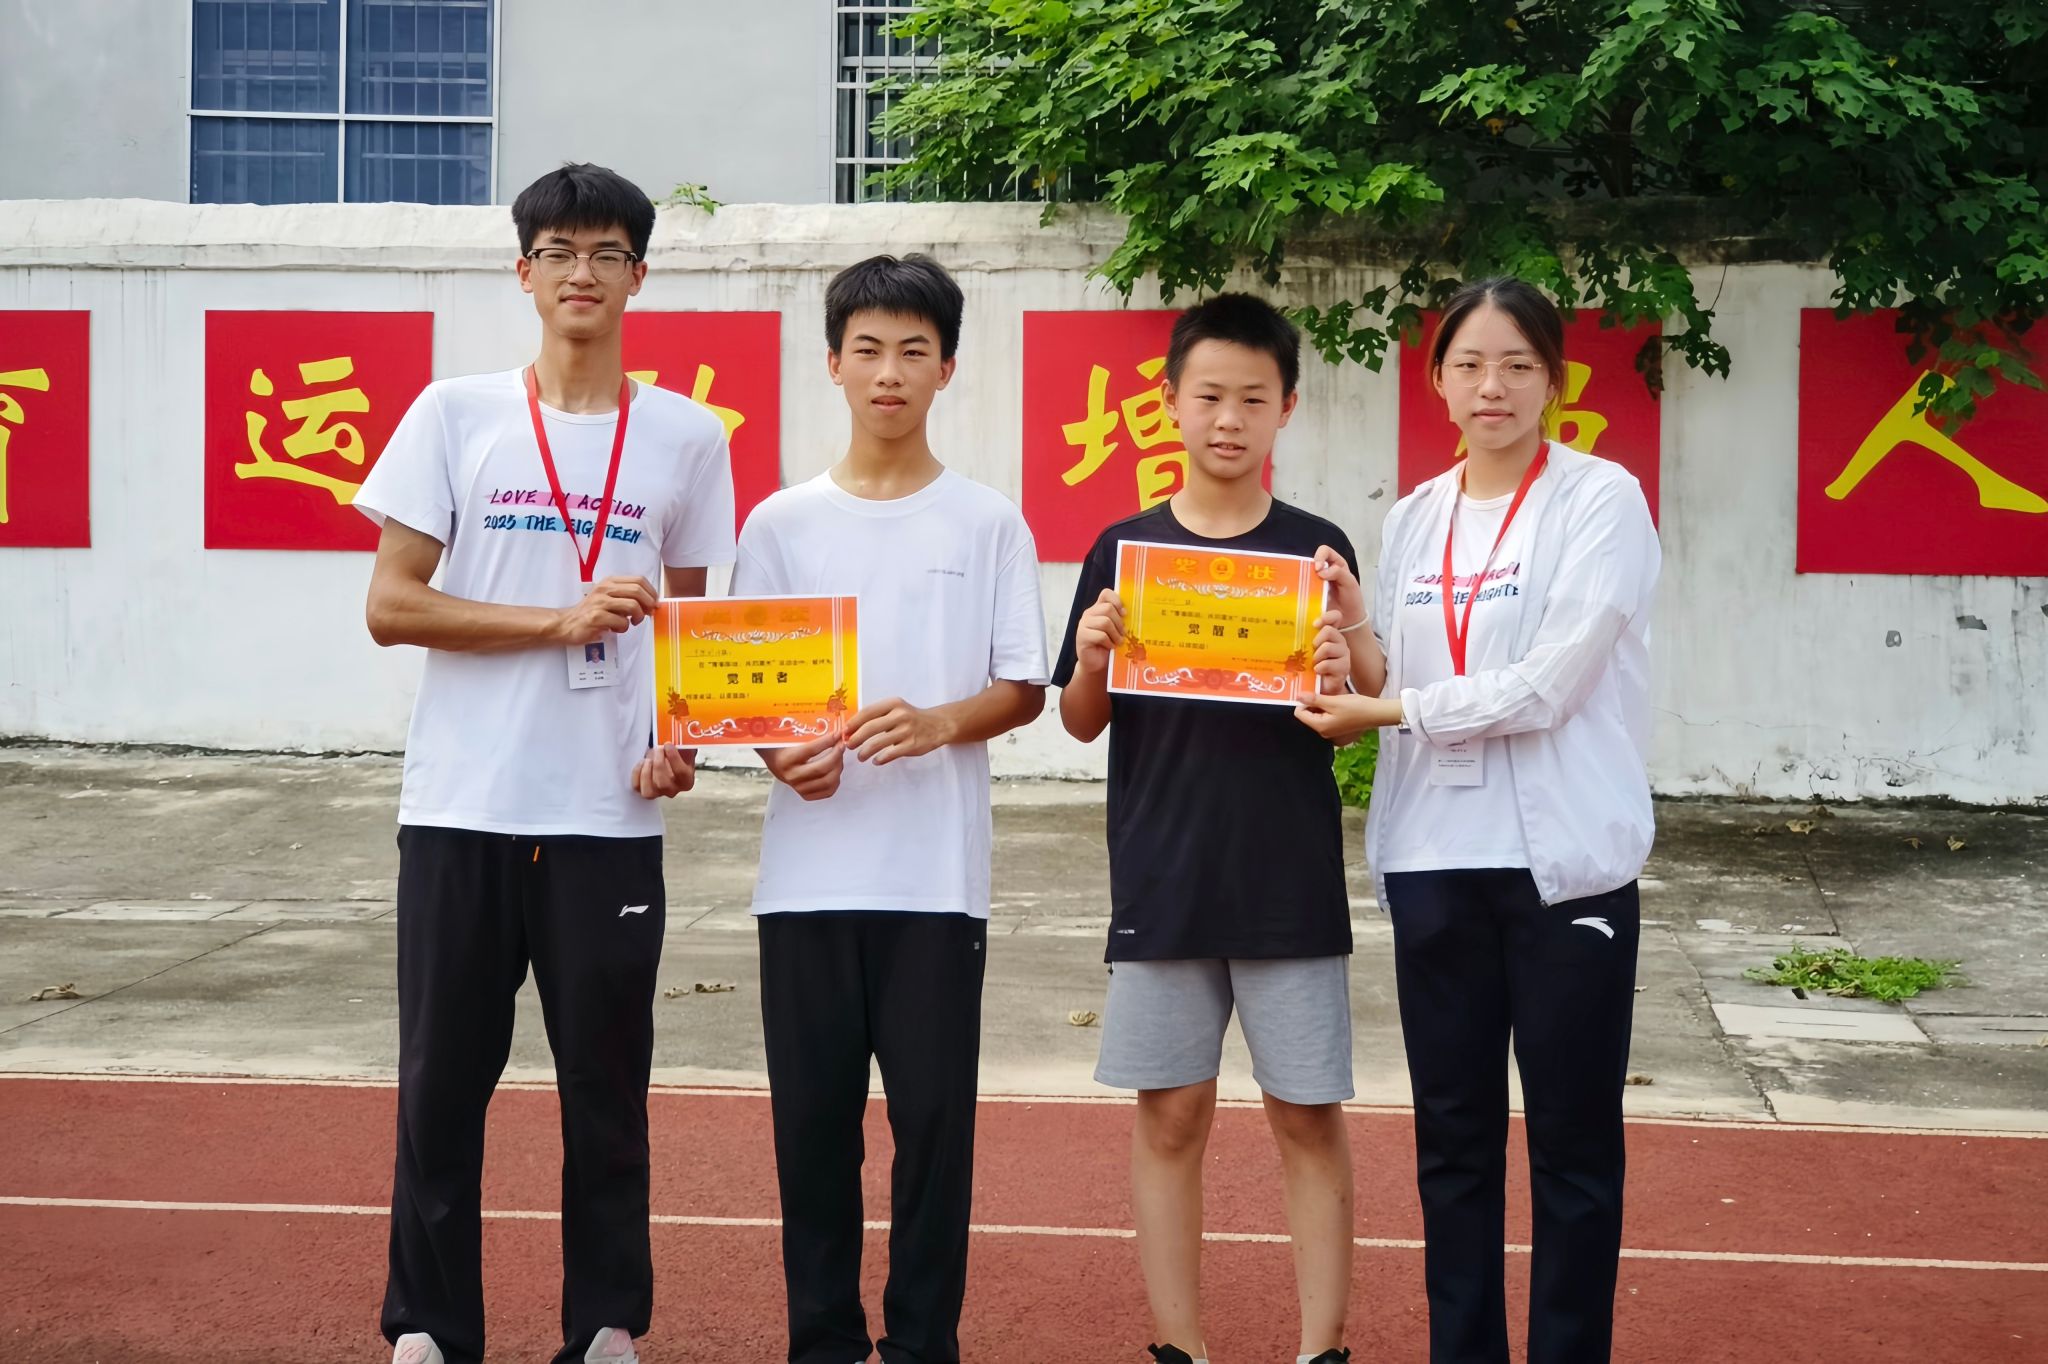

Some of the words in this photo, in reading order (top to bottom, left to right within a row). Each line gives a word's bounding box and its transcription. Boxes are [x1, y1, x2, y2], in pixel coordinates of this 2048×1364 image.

[234, 356, 370, 505] 运
[1824, 369, 2048, 513] 人
[490, 488, 537, 504] LOVE
[577, 494, 646, 519] ACION
[484, 515, 516, 530] 2025
[524, 514, 557, 531] THE
[564, 518, 642, 544] EIGTEEN
[727, 671, 788, 685] 觉醒者
